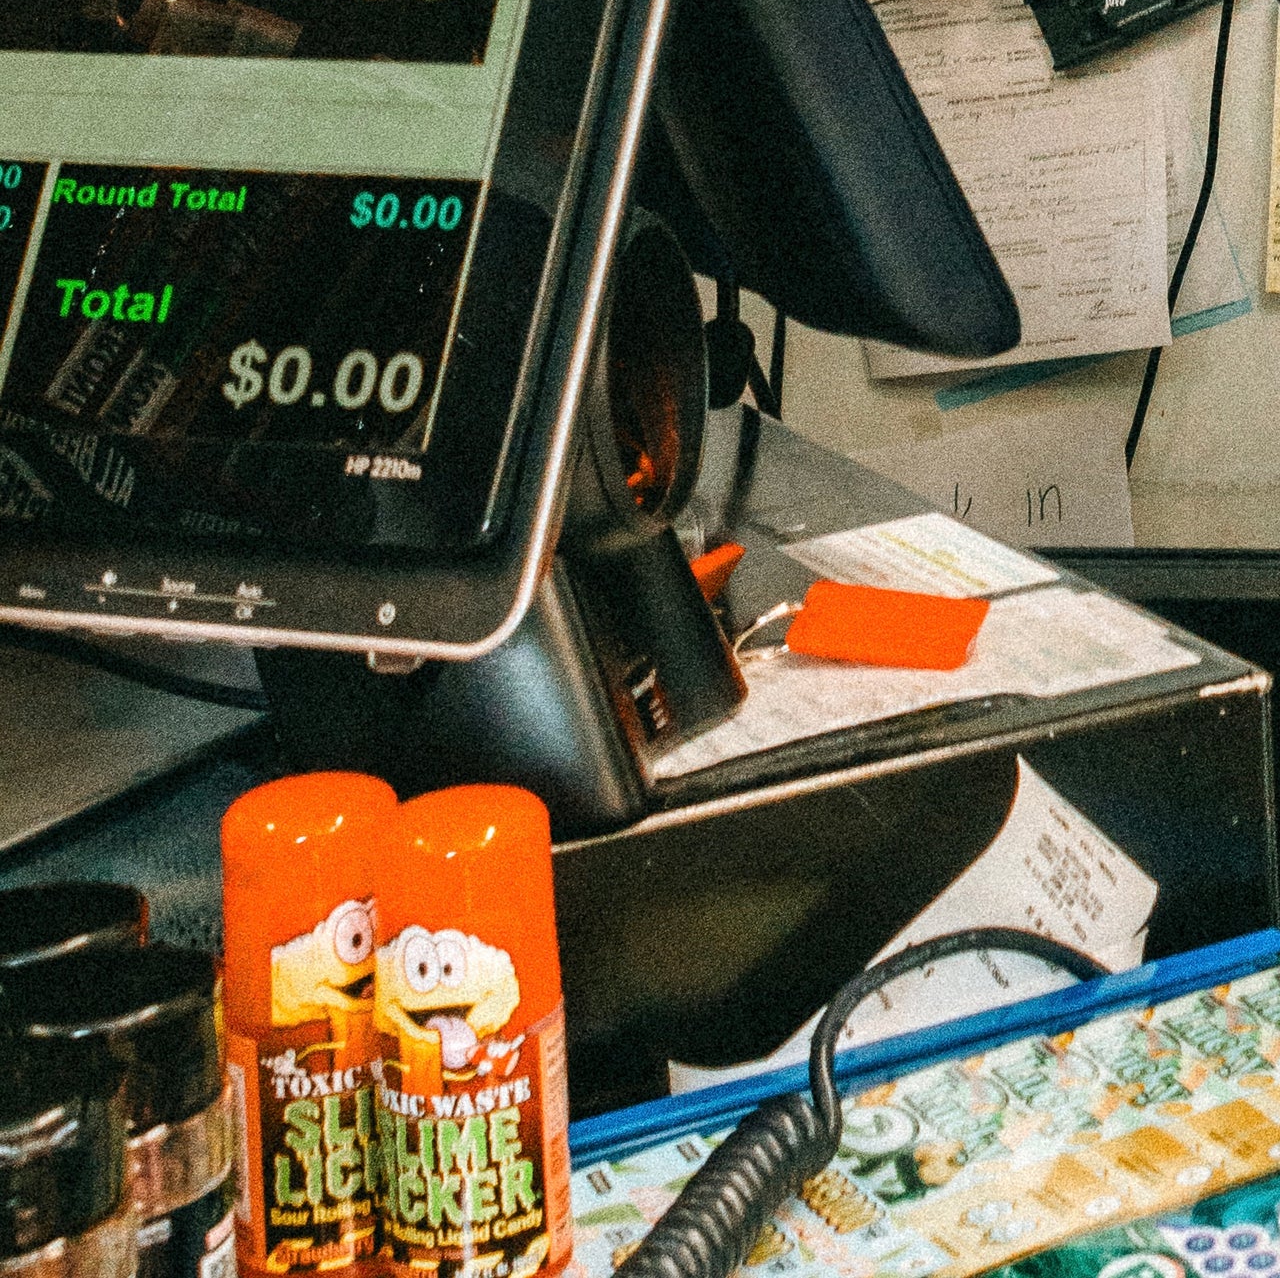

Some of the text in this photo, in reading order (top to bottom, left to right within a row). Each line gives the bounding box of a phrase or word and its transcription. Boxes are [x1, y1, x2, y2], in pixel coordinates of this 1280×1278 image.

[53, 177, 158, 209] Round
[169, 180, 248, 213] Total
[348, 190, 464, 232] $0.00
[54, 278, 175, 324] Total
[222, 338, 425, 414] $0.00
[345, 455, 369, 476] HP
[271, 1065, 362, 1100] TOXIC
[431, 1075, 531, 1119] WASTE
[493, 1207, 544, 1238] Candy
